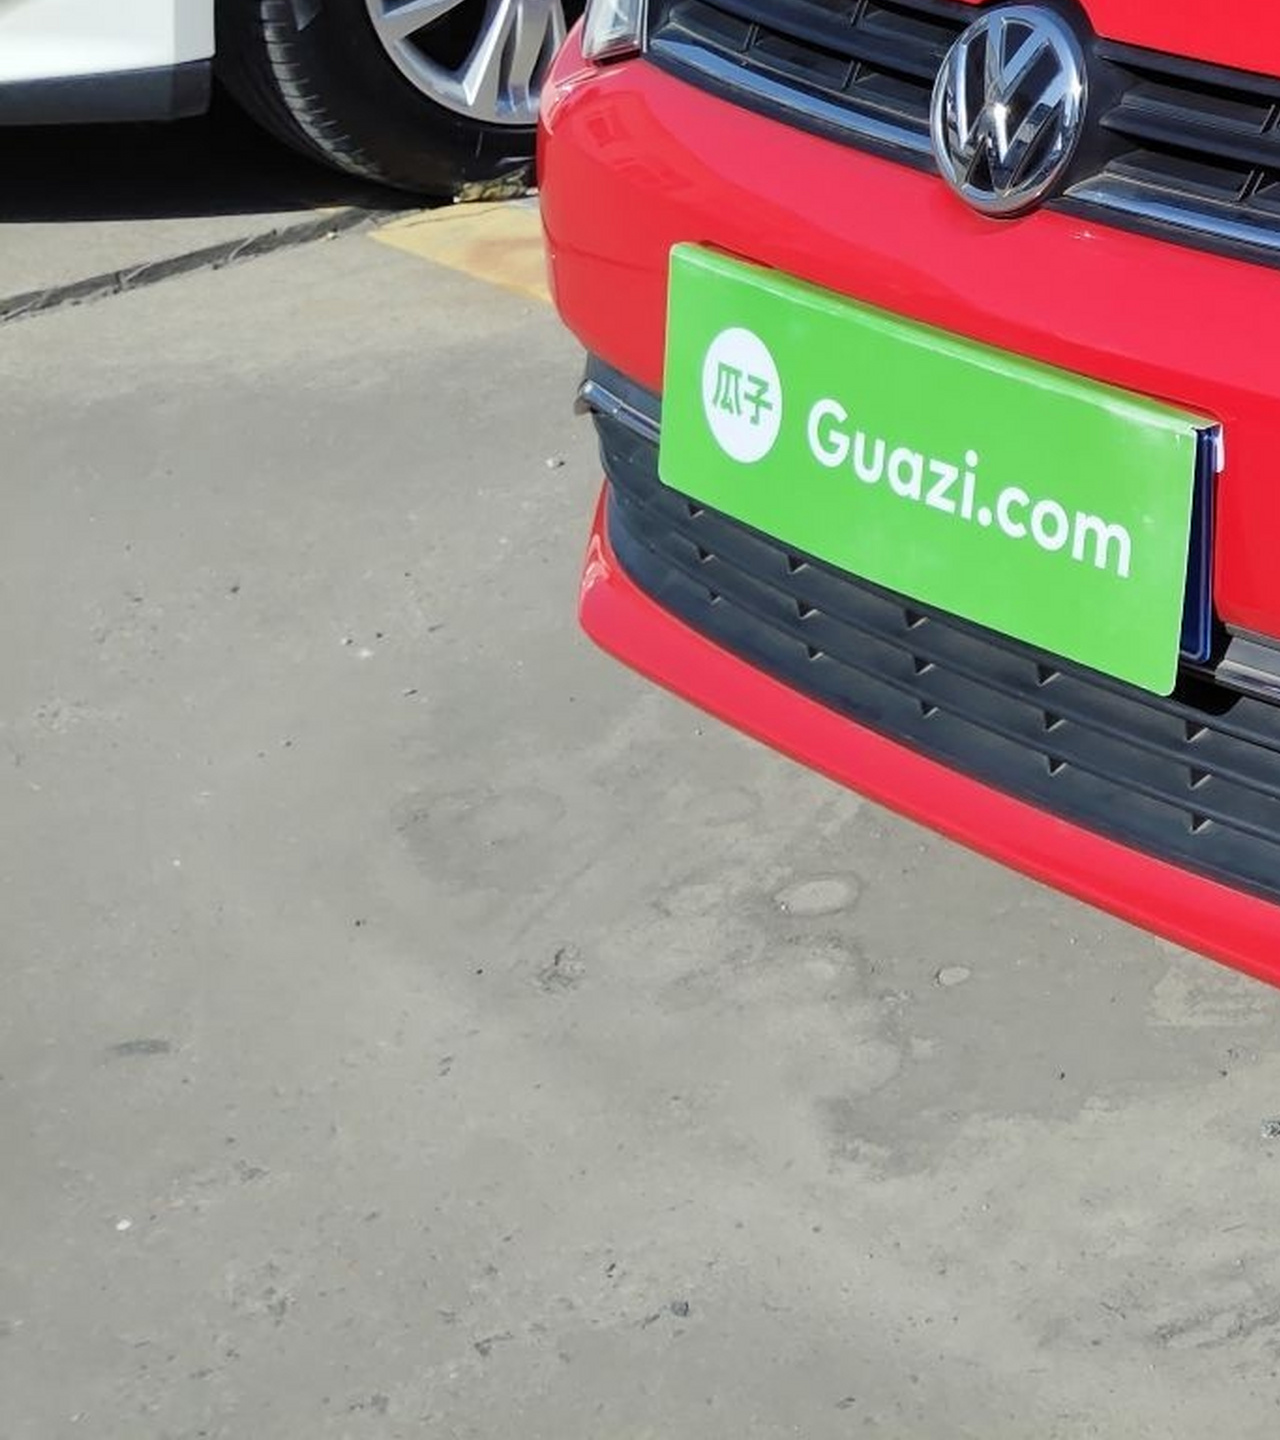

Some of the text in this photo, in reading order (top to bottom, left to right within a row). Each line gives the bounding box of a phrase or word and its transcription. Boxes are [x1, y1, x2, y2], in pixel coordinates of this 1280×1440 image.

[936, 6, 1085, 208] VW
[713, 361, 773, 425] 瓜子
[807, 398, 1132, 578] Guazi.com
